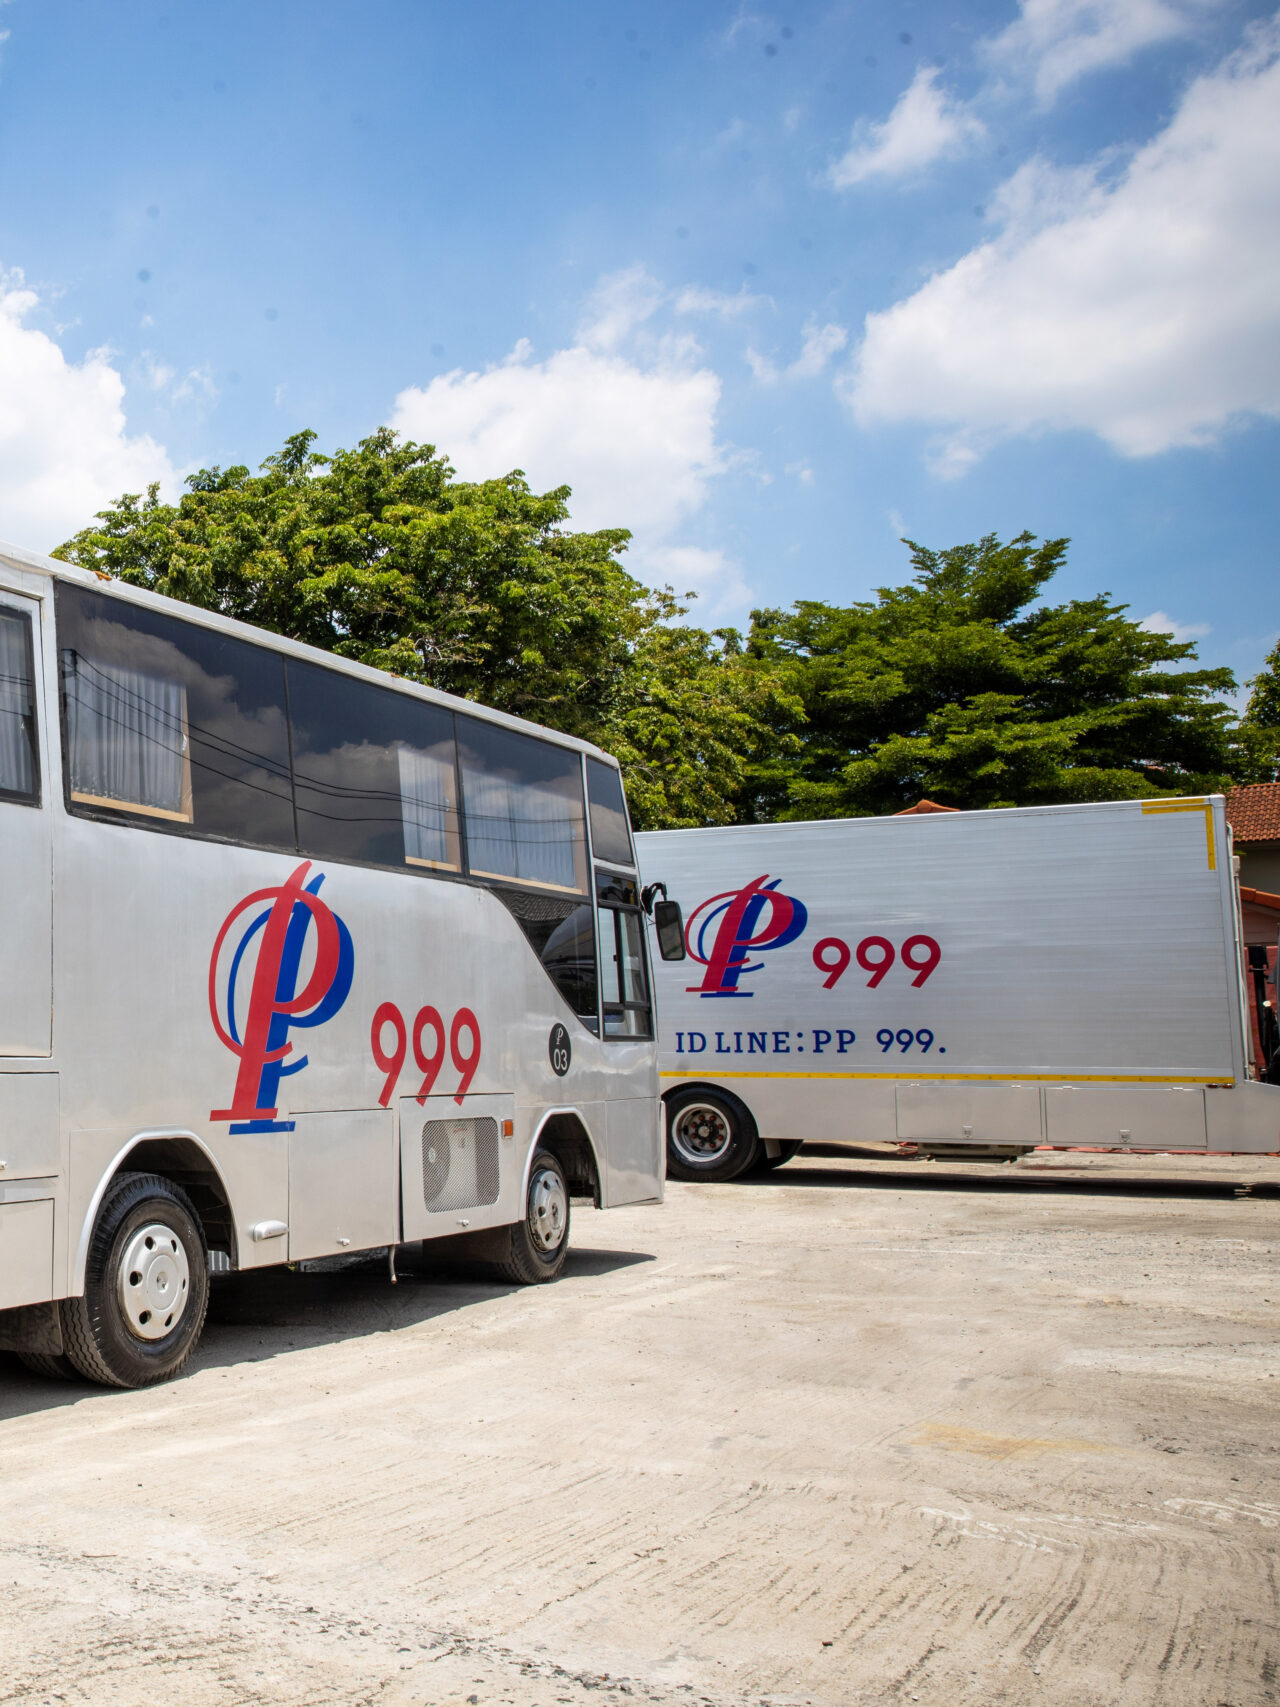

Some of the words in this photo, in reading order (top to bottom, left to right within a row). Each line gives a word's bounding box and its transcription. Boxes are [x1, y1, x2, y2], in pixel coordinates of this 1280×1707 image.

[812, 934, 941, 989] 999
[371, 1001, 481, 1108] 999
[553, 1048, 568, 1071] 03
[675, 1032, 707, 1053] ID
